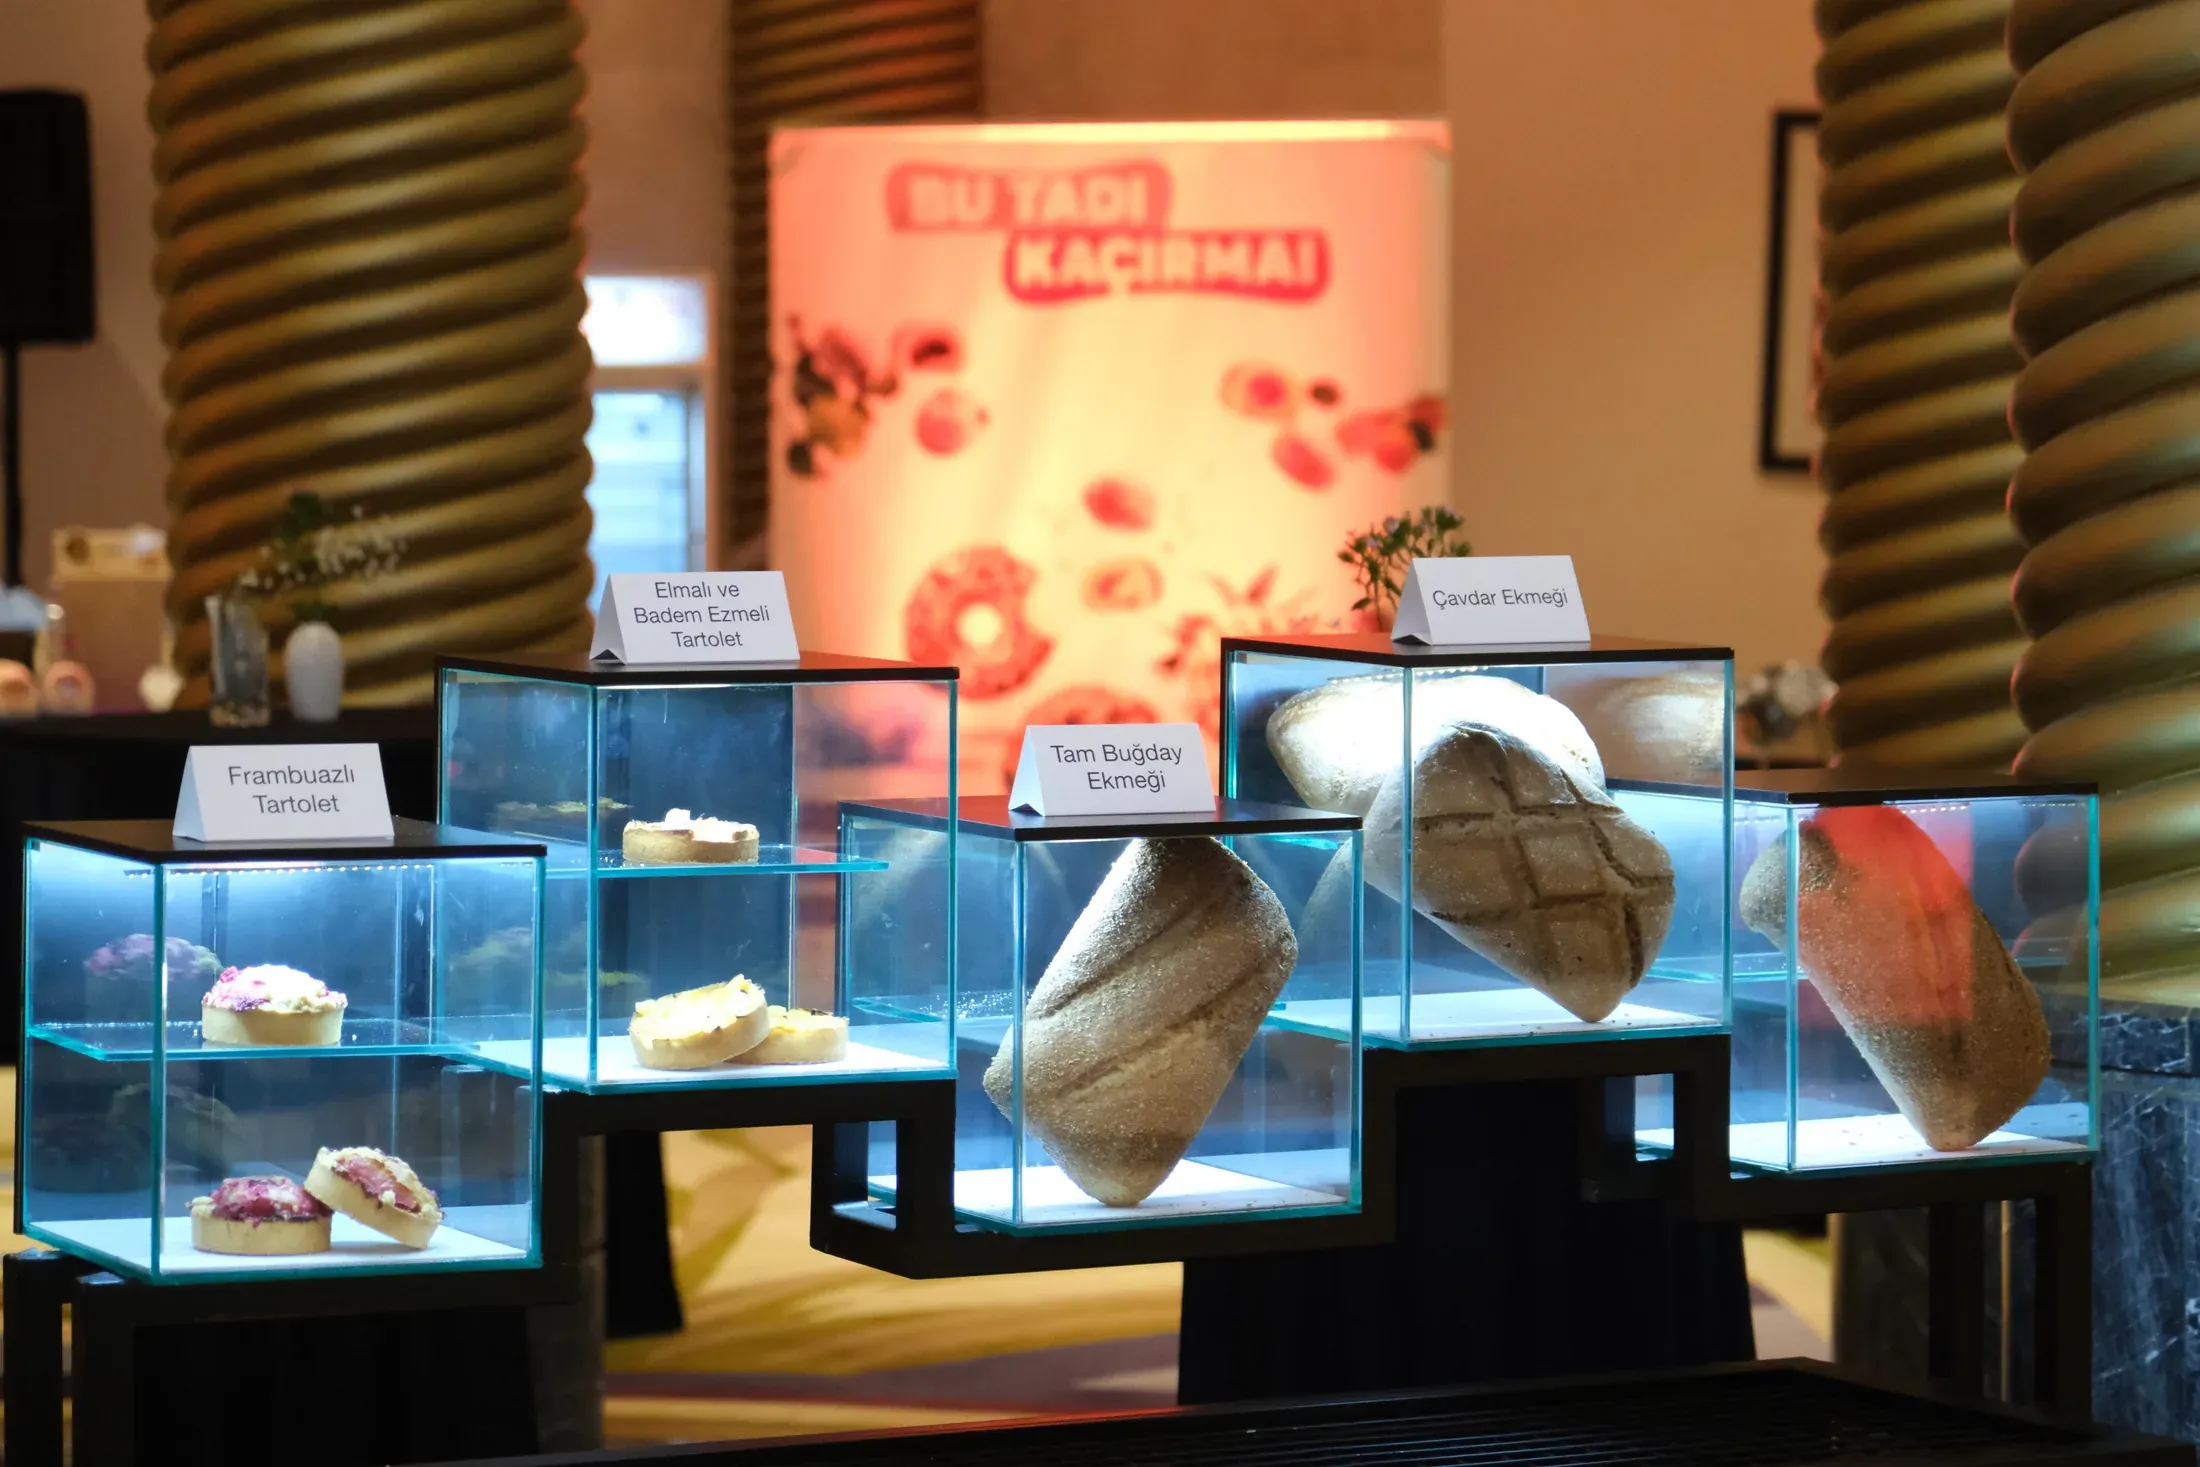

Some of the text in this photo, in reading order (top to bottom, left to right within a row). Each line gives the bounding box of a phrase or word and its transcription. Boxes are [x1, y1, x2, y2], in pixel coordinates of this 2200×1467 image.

[907, 174, 995, 225] BU
[654, 582, 740, 599] Elmalı ve
[1432, 587, 1569, 610] Çavdar Ekmeği
[633, 605, 770, 624] Badem Ezmeli
[670, 631, 744, 648] Tartolet
[1049, 742, 1183, 767] Tam Buğday
[228, 764, 356, 786] Frambuazlı
[1086, 769, 1166, 794] Ekmeği
[252, 794, 341, 814] Tartolet
